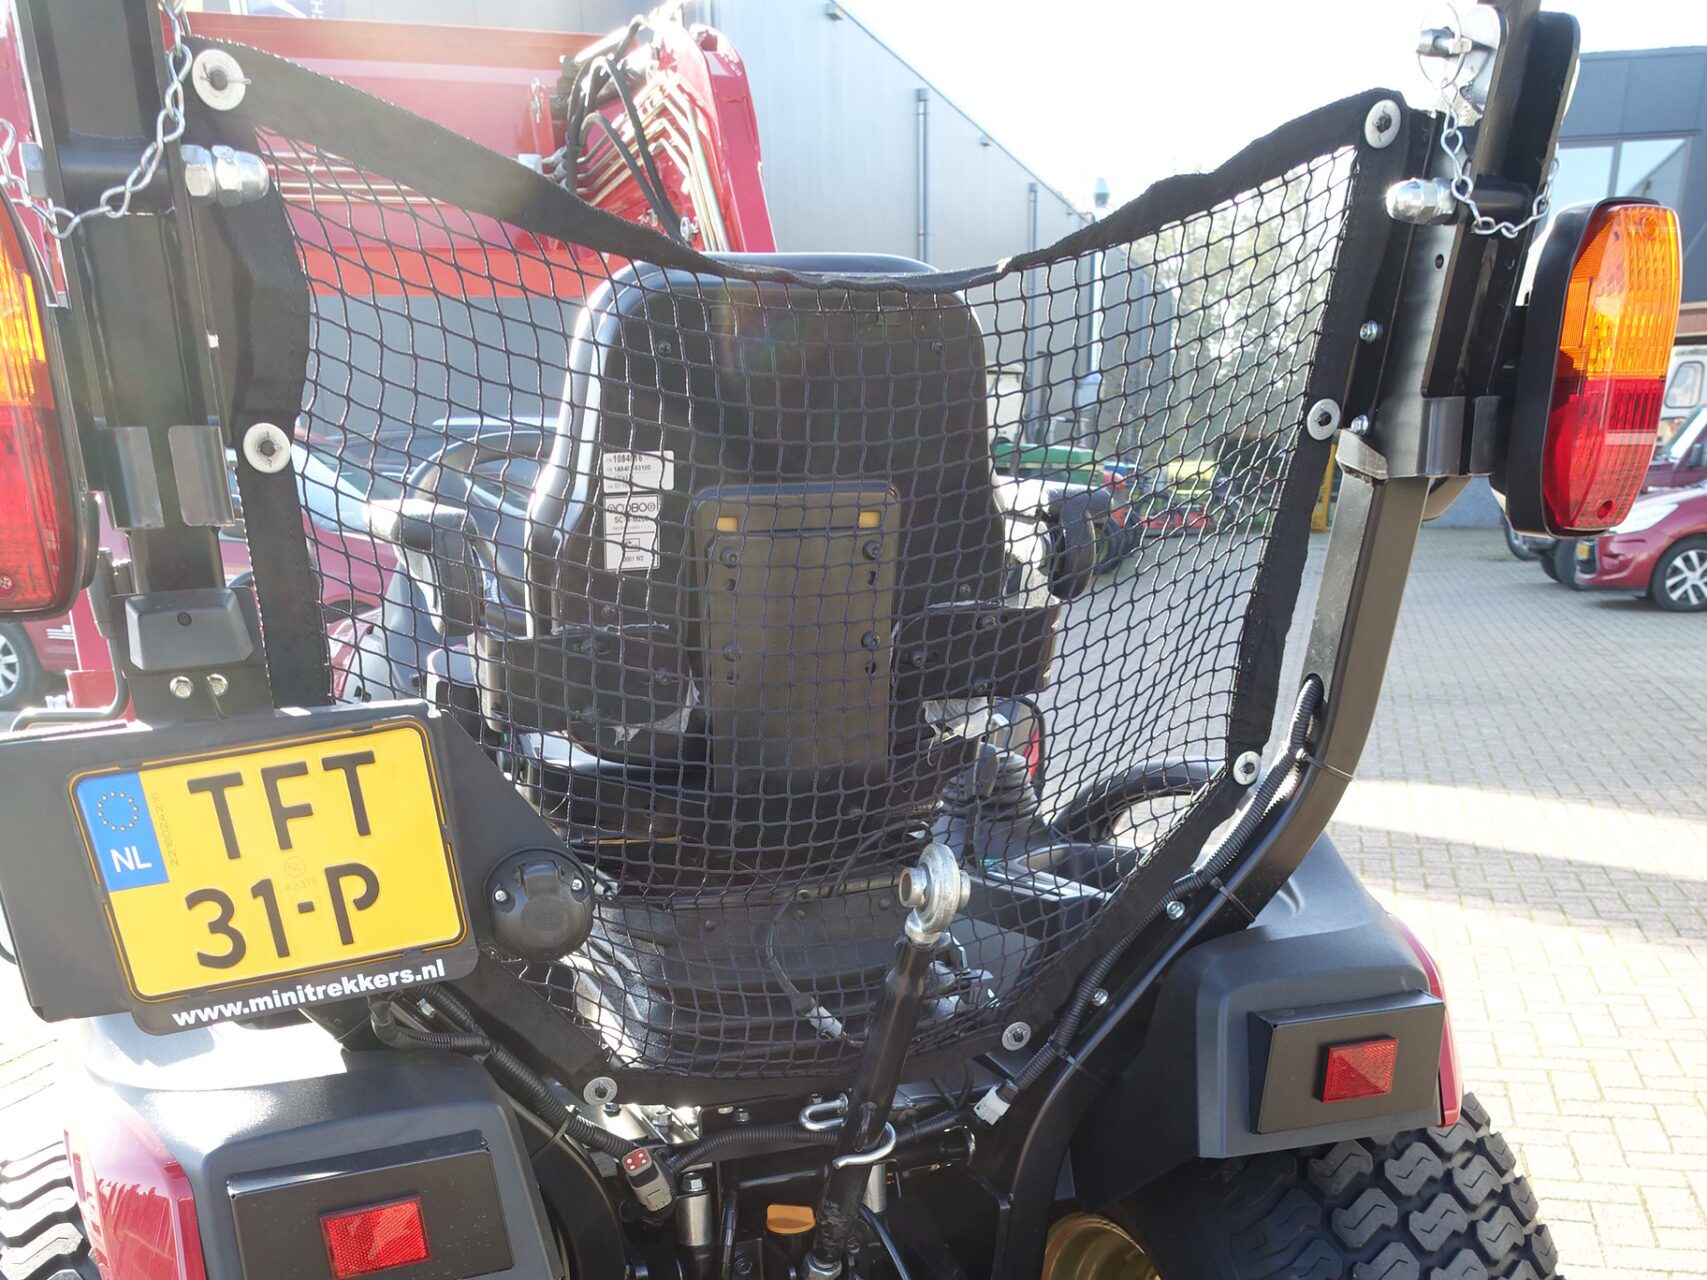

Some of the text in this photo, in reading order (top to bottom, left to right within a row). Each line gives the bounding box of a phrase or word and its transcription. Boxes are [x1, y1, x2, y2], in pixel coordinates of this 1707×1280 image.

[187, 750, 376, 860] TFT
[110, 845, 152, 873] NL
[185, 862, 380, 969] 31-P
[172, 959, 446, 1027] www.minitrekkers.nl
